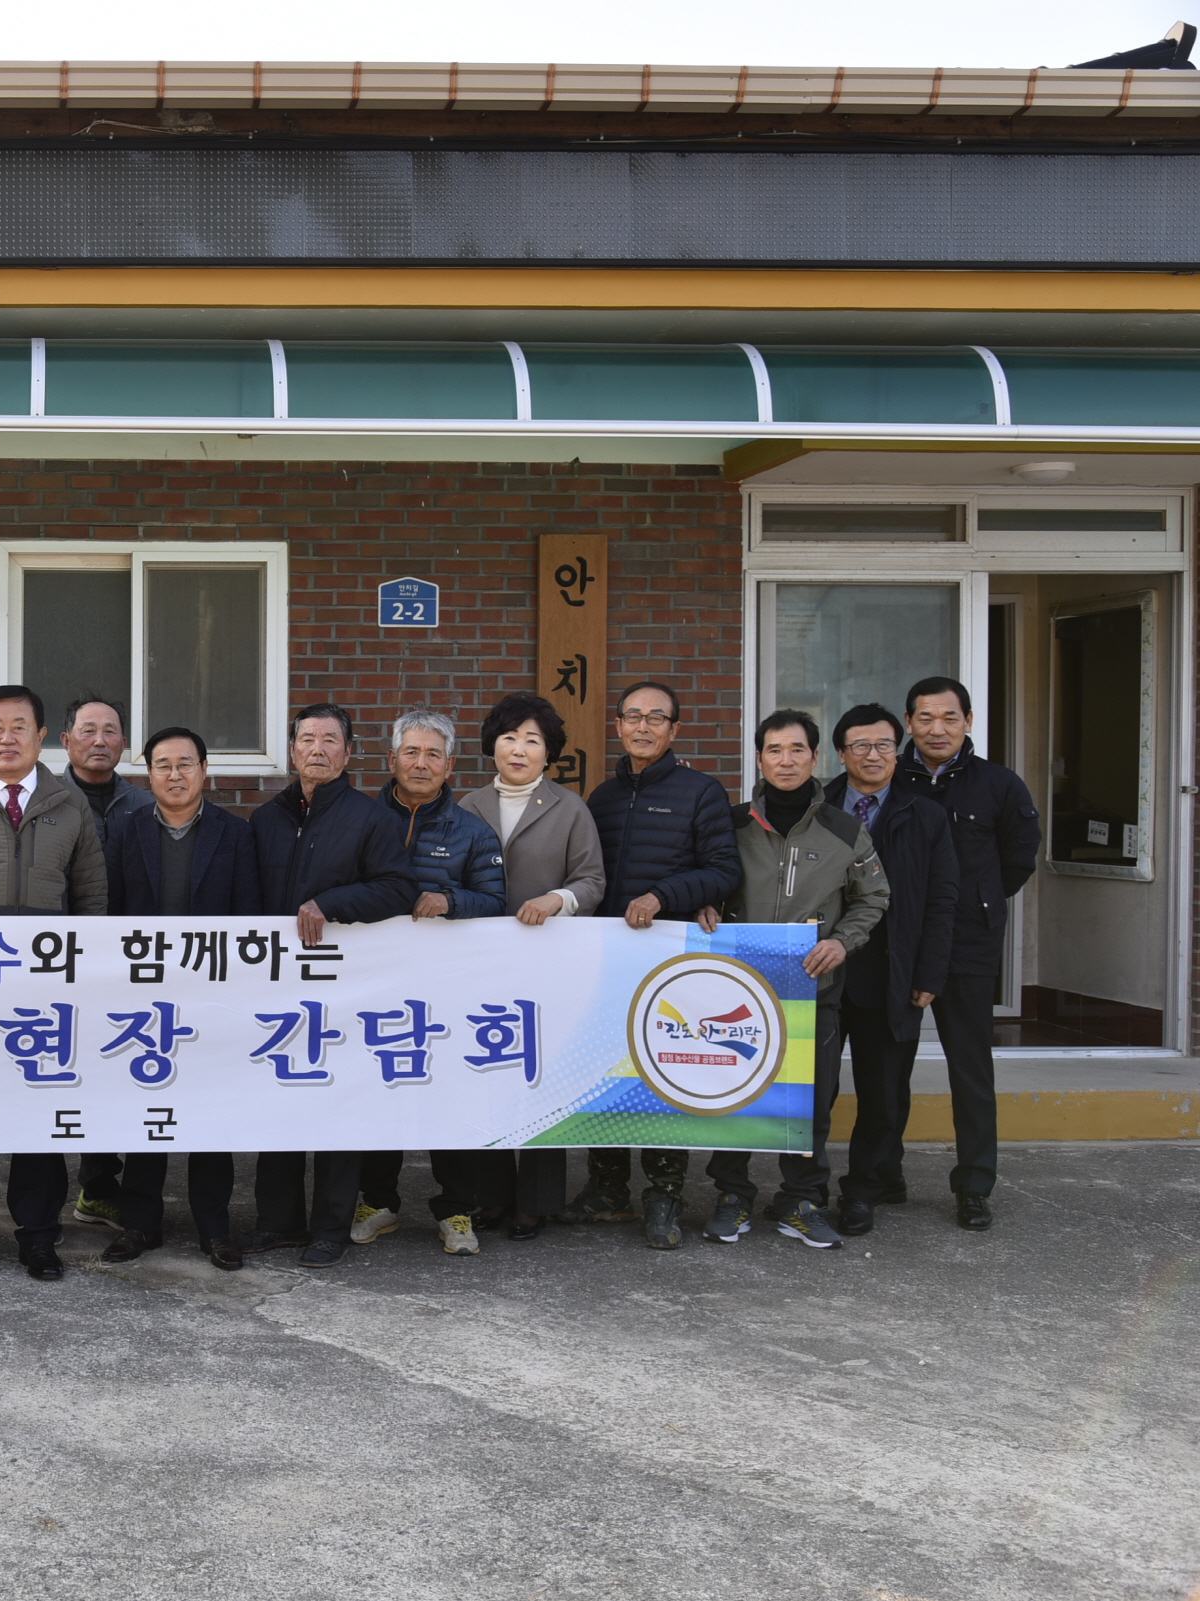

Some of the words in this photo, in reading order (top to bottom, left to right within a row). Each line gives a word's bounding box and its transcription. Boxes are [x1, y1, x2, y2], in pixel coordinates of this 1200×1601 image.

[392, 602, 425, 620] 2-2
[398, 584, 419, 592] 안치길
[551, 556, 596, 797] 안치리
[119, 929, 344, 984] 함께하는
[248, 998, 538, 1084] 간담회
